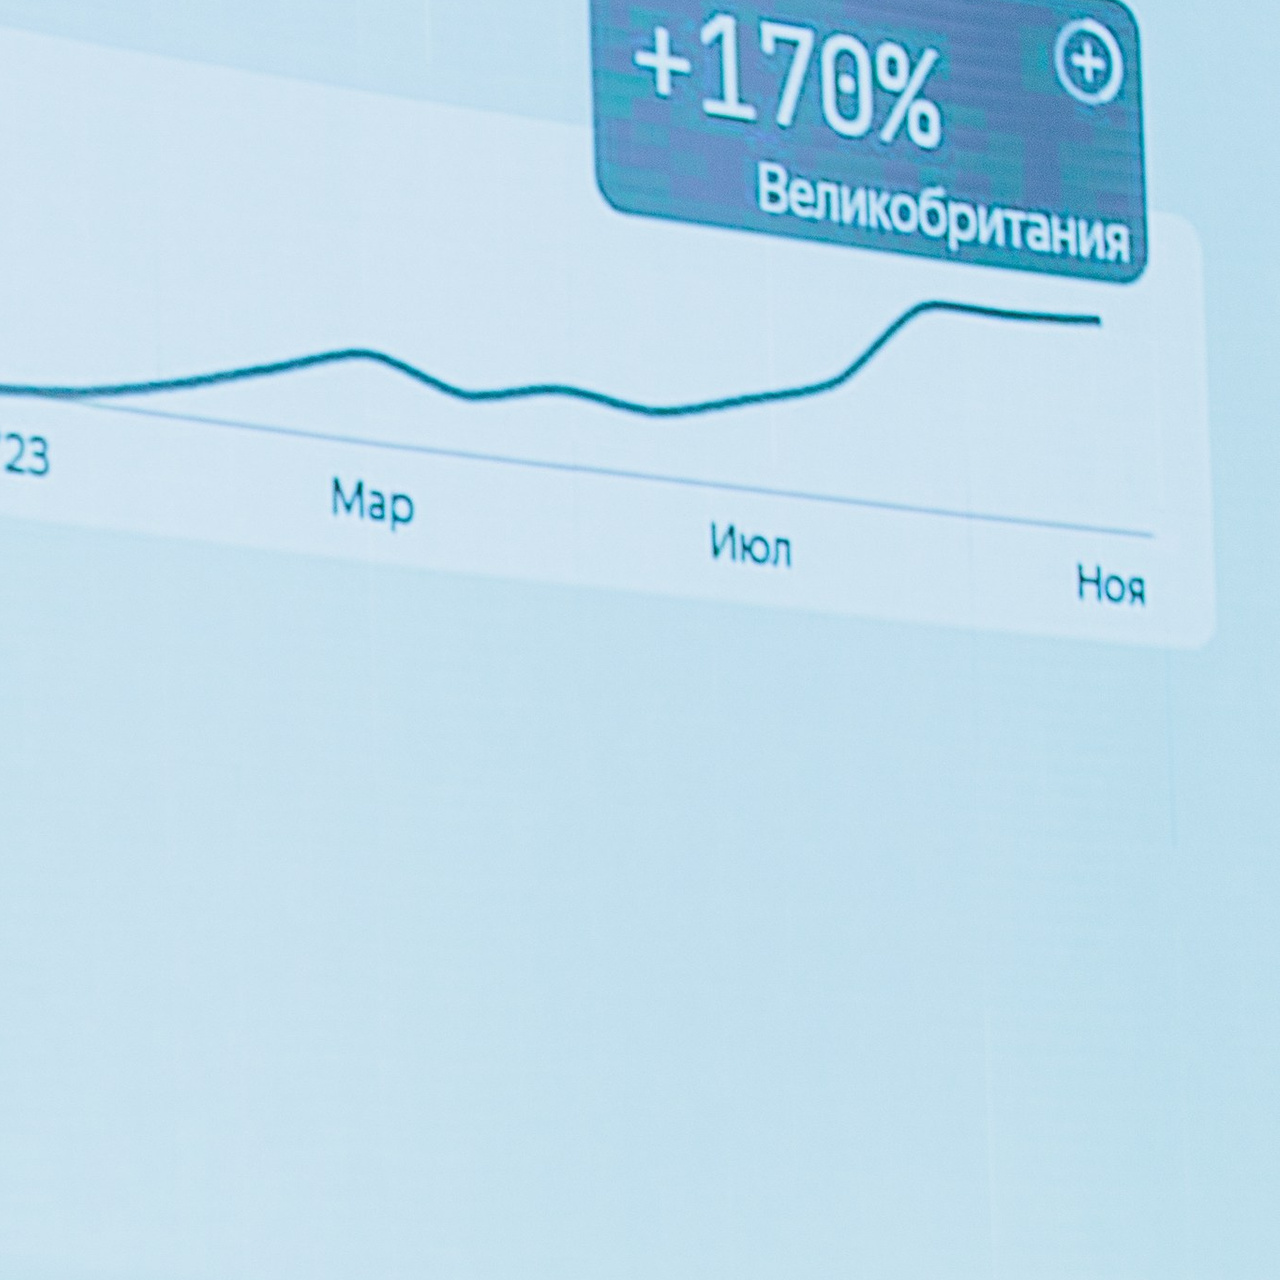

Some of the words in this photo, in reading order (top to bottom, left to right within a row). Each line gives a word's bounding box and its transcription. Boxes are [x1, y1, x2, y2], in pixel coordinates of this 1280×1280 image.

[633, 12, 943, 150] +170%
[757, 160, 1132, 264] Великобритания
[331, 476, 415, 532] Мар
[710, 521, 793, 569] Июл
[1076, 562, 1146, 606] Ноя
